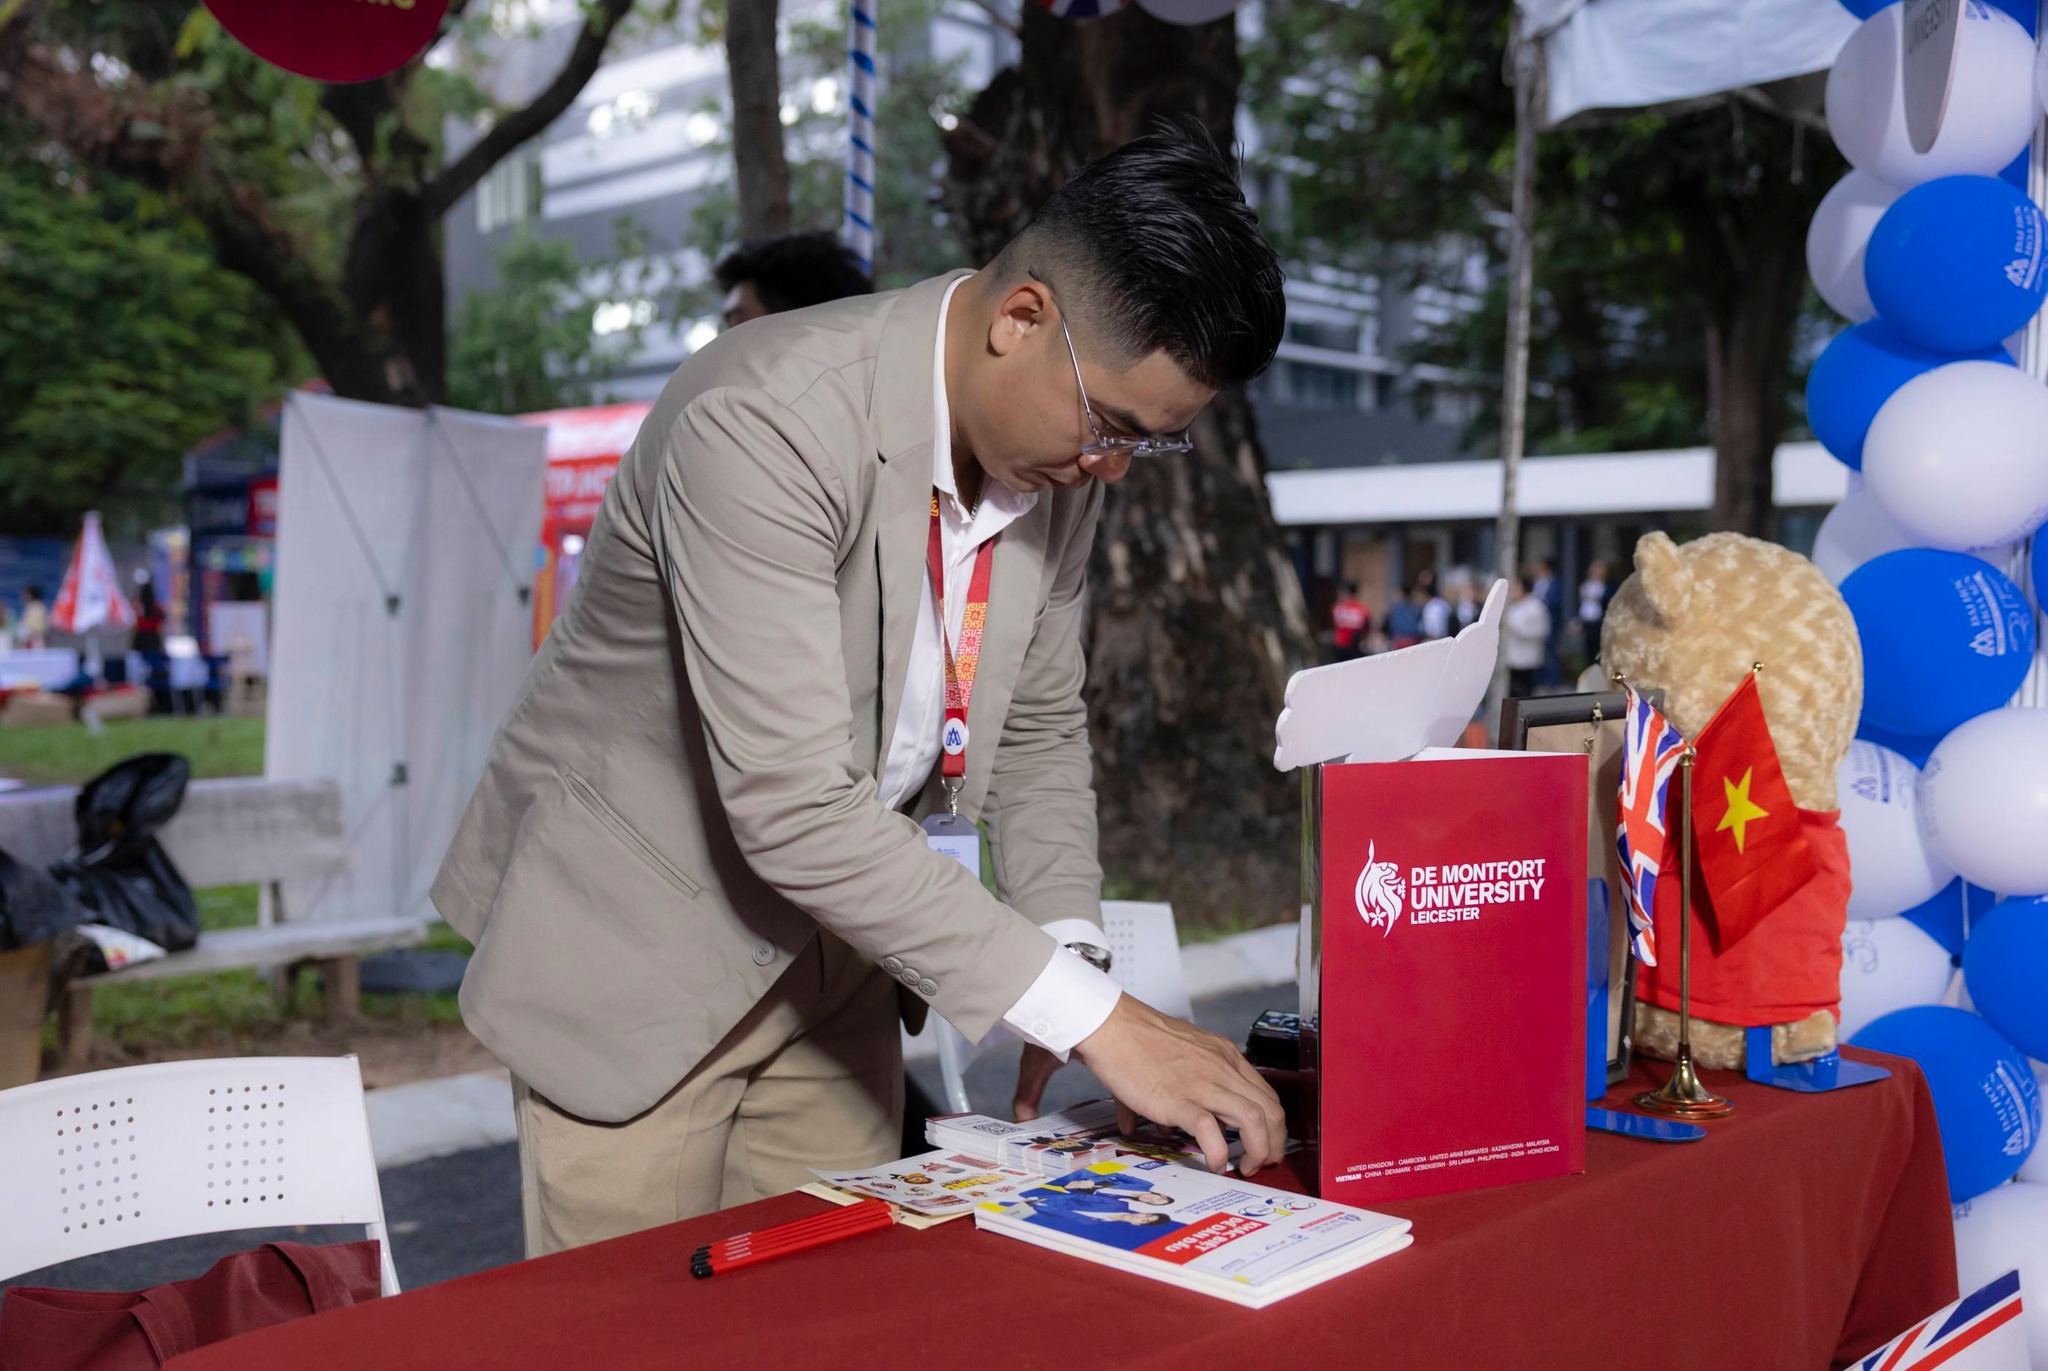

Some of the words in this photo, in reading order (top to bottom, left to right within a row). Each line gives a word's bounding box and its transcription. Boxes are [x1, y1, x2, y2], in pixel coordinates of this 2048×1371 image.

[1411, 866, 1437, 886] DE
[1442, 859, 1545, 884] MONTFORT
[1411, 878, 1545, 909] UNIVERSITY
[1410, 907, 1480, 924] LEICESTER
[1335, 1173, 1361, 1183] VIETNAM
[1364, 1170, 1382, 1179] CHINA
[1384, 1166, 1411, 1176] DENMARK
[1414, 1161, 1446, 1171] UZBEKISTAN
[1458, 1157, 1475, 1165] LANKA
[1477, 1152, 1508, 1162] PHILIPPINES
[1511, 1150, 1525, 1158] INDIA
[1527, 1147, 1543, 1155] HONG
[1543, 1145, 1560, 1153] KONG
[1347, 1163, 1367, 1173] UNITED
[1367, 1160, 1394, 1171] KINGDOM
[1398, 1156, 1427, 1165] CAMBODIA
[1429, 1153, 1449, 1161] UNITED
[1449, 1150, 1464, 1158] ARAB
[1464, 1147, 1488, 1156] EMIRATES
[1491, 1143, 1524, 1152] KAZAKHSTAN
[1526, 1139, 1550, 1147] MALAYSIA
